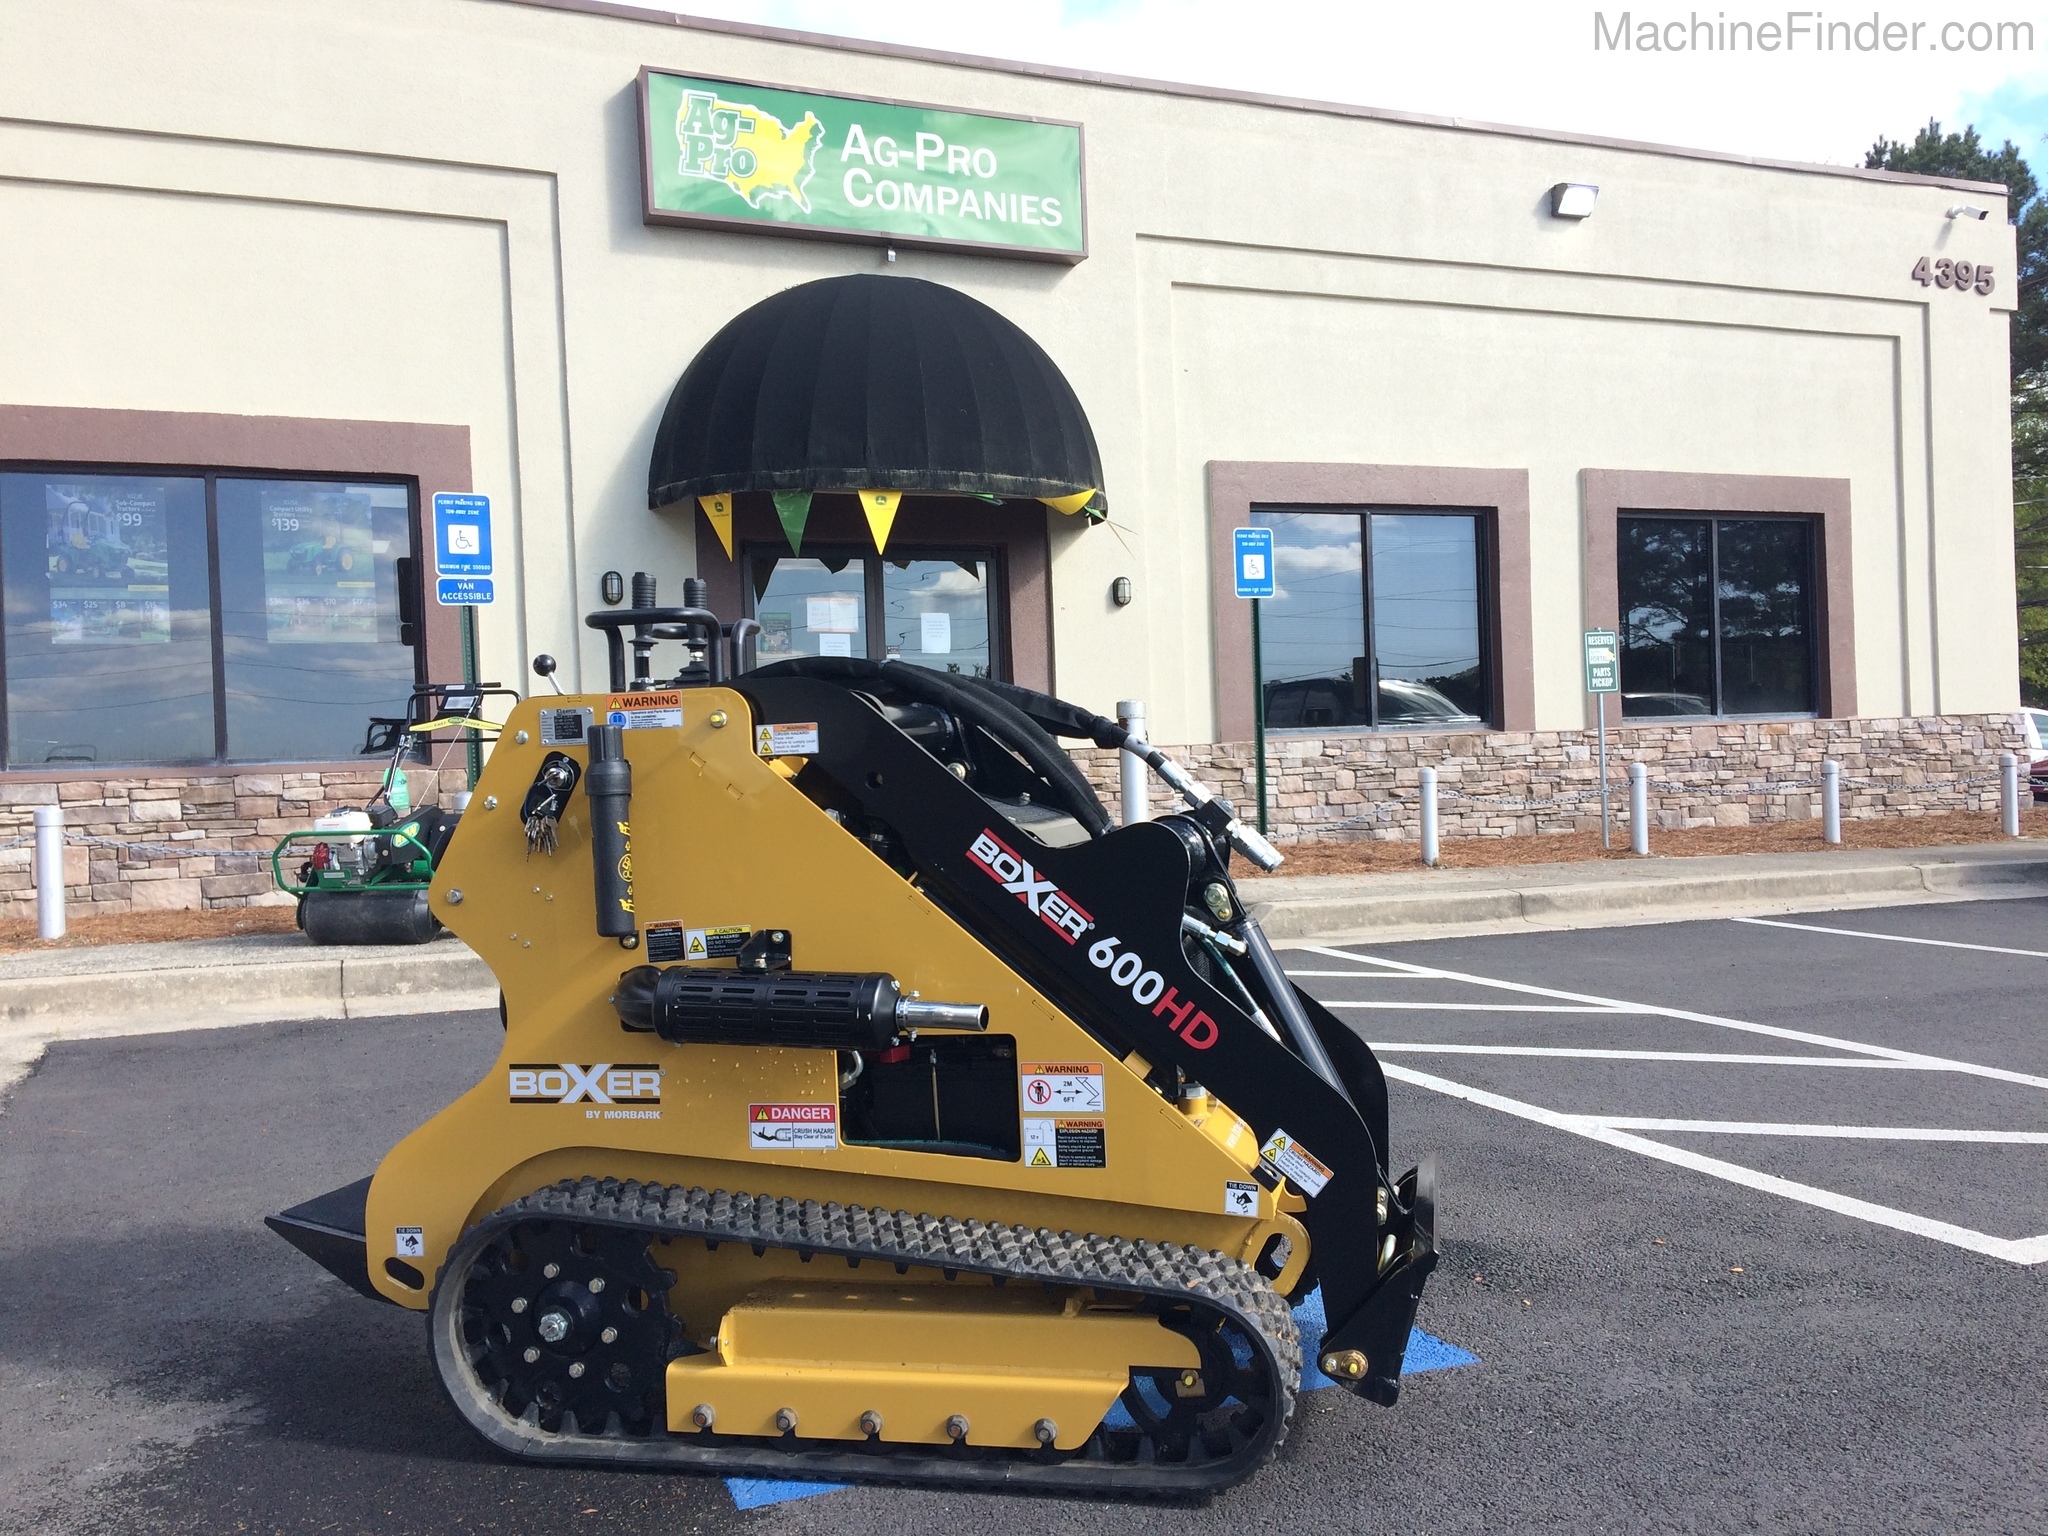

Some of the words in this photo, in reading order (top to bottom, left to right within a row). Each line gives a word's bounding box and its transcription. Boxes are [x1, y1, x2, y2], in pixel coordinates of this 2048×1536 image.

[680, 97, 757, 147] Ag-
[679, 134, 759, 178] Pro
[842, 167, 1063, 228] COMPANIES
[1911, 256, 1996, 296] 4395
[116, 513, 143, 526] $99
[271, 518, 300, 531] $139
[457, 582, 474, 590] VAN
[441, 592, 492, 600] ACCESSIBLE
[83, 601, 98, 609] $25
[1587, 635, 1614, 645] RESERVED
[1592, 667, 1612, 677] PARTS
[1591, 677, 1614, 688] PICKUP
[622, 694, 679, 708] WARNING
[969, 832, 1089, 940] BOXER
[1088, 936, 1219, 1050] 600HD
[1045, 1065, 1090, 1074] WARNING
[509, 1063, 661, 1104] BOXER
[585, 1110, 601, 1119] BY
[604, 1110, 661, 1119] MORBARK
[771, 1107, 831, 1120] DANGER
[1238, 1183, 1257, 1191] DOWN
